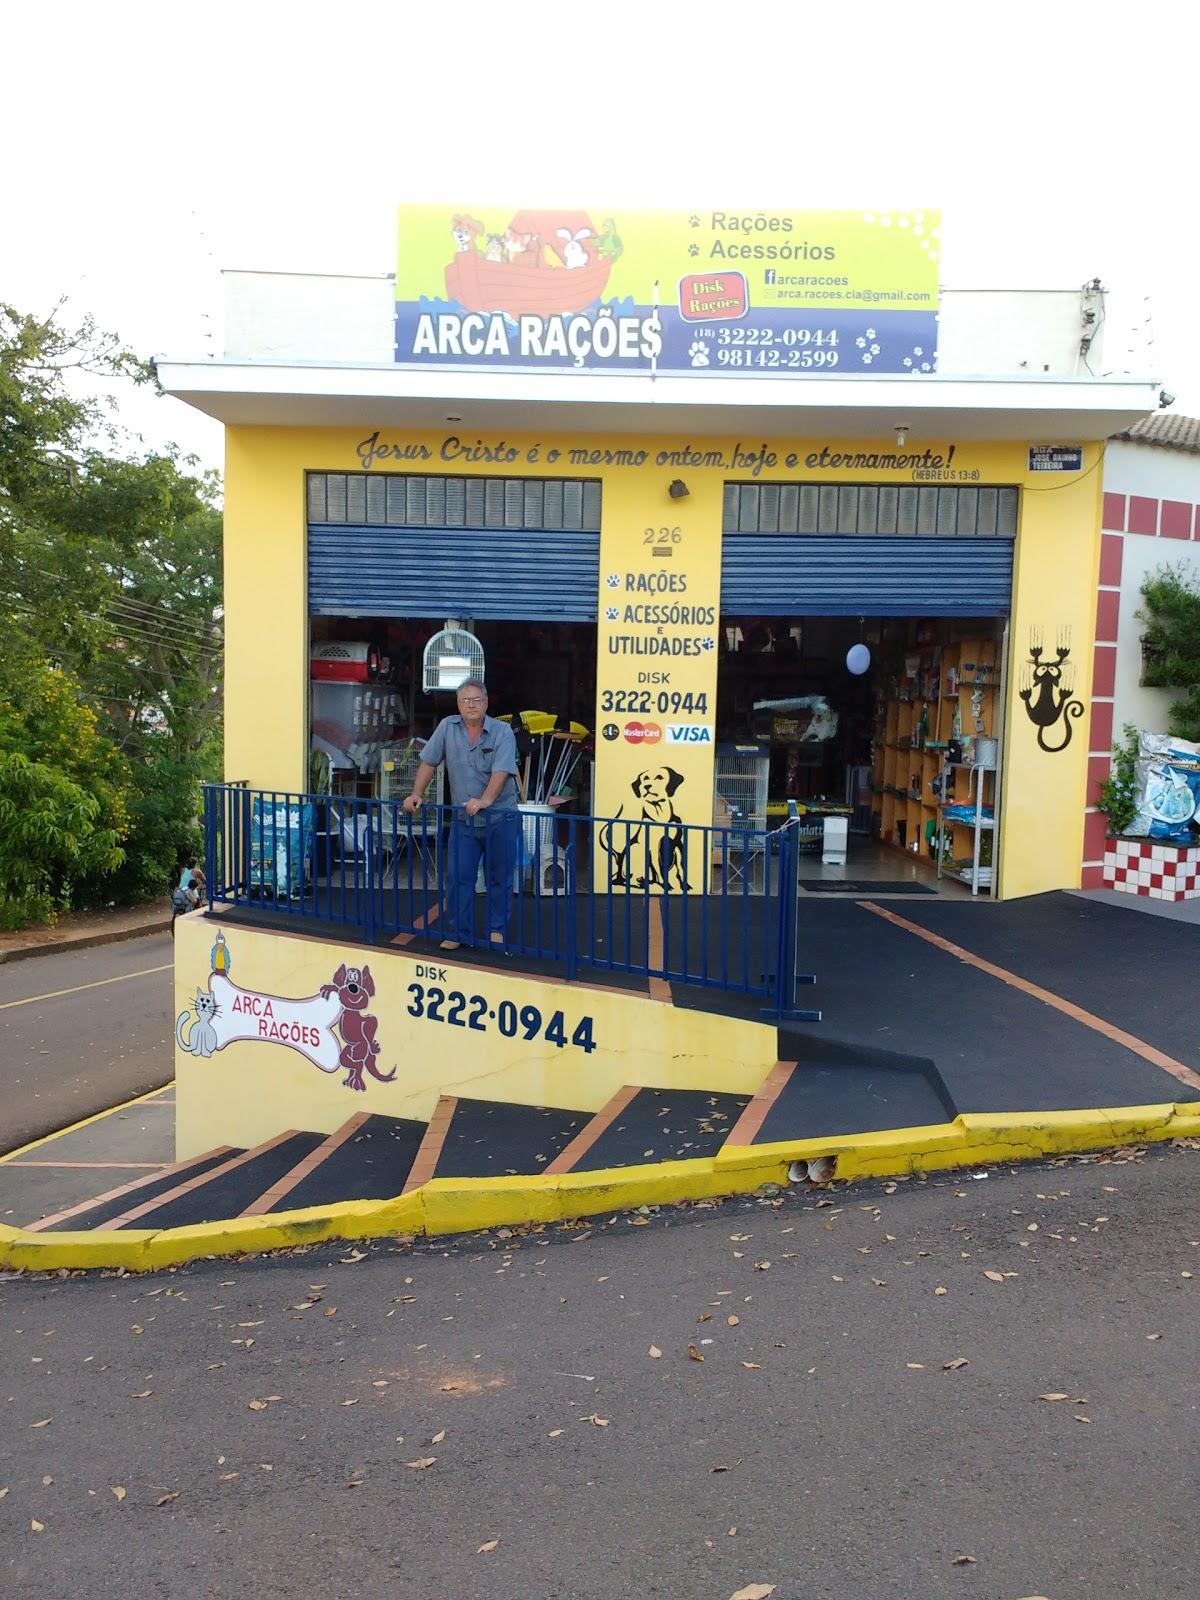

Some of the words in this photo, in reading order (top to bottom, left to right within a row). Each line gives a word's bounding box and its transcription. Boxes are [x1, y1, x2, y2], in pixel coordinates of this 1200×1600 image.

[711, 212, 793, 235] Rações
[710, 240, 836, 261] Acessórios
[693, 280, 725, 296] Disk
[777, 275, 848, 286] arcaracoes
[688, 297, 740, 314] Rações
[777, 290, 931, 302] arca.racoes.cia@gmail.com
[412, 314, 510, 356] ARCA
[520, 308, 663, 368] RAÇÕES
[694, 328, 716, 339] (18)
[717, 328, 840, 347] 3222-0944
[717, 349, 839, 368] 98142-2599
[356, 431, 432, 470] Jesus
[440, 436, 520, 464] Cristo
[526, 443, 540, 464] é
[547, 449, 562, 464] o
[568, 449, 649, 467] mesmo
[730, 442, 778, 477] hoje
[785, 452, 800, 468] e
[805, 445, 956, 470] eternamente!
[911, 469, 956, 481] (HEBREUS
[958, 469, 981, 481] 13:8)
[642, 526, 682, 545] 226
[625, 570, 687, 596] RAÇÕES
[623, 601, 715, 626] ACESSÓRIOS
[656, 626, 664, 635] E
[608, 635, 703, 657] UTILIDADES
[637, 671, 671, 684] DISK
[601, 689, 708, 715] 3222-0944
[623, 728, 660, 738] MasterCard
[667, 727, 711, 742] VISA
[415, 964, 448, 983] DISK
[232, 994, 274, 1019] ARCA
